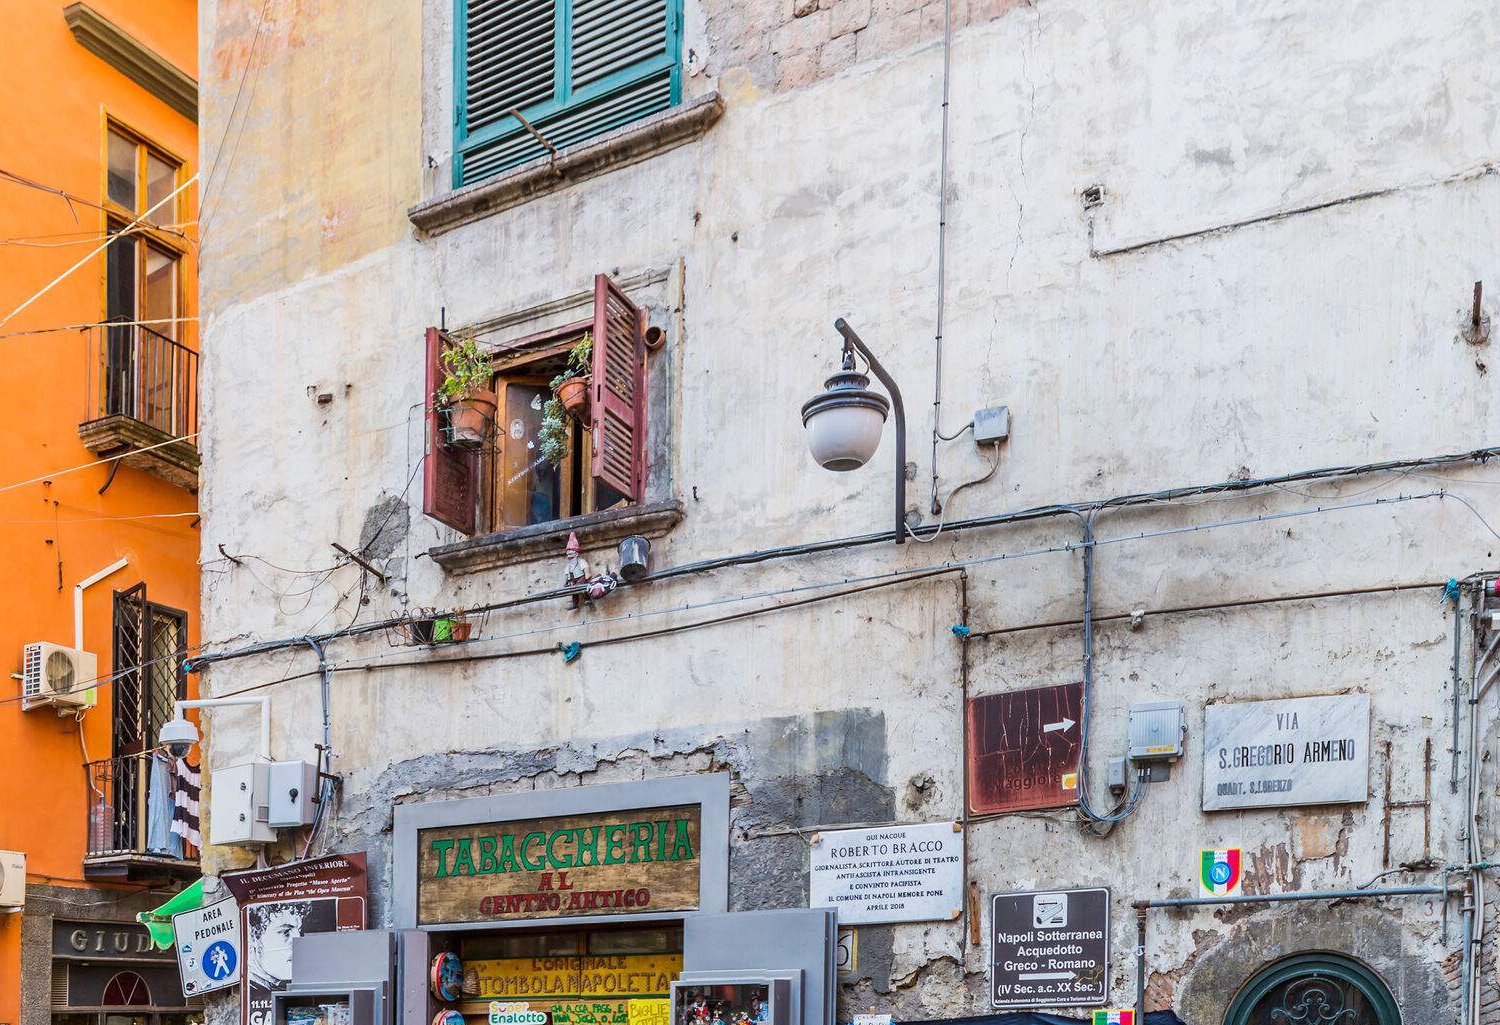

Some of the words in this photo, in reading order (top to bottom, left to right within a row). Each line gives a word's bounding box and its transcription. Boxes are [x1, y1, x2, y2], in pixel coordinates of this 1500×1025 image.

[1276, 712, 1299, 730] VIA
[1219, 743, 1294, 769] S.GREGORIO
[1303, 738, 1355, 763] ARMENO
[879, 832, 906, 840] NACQUE
[431, 818, 694, 879] TABACCHERIA
[831, 844, 888, 858] ROBERTO
[893, 840, 943, 854] BRACCO
[895, 858, 922, 866] AUTORE
[933, 856, 959, 864] TEATRO
[251, 867, 301, 883] DECUMANO
[303, 860, 349, 871] INFERIORE
[836, 871, 881, 880] ANTIFASCISTA
[883, 868, 936, 877] INTRANSIGENTE
[538, 872, 574, 891] AL
[855, 881, 889, 890] CONVINTO
[317, 887, 330, 895] Open
[836, 894, 863, 902] COMUNE
[898, 890, 924, 898] MEMORE
[926, 889, 943, 897] PONE
[479, 892, 560, 915] CENTRO
[567, 887, 650, 910] ANTICO
[1424, 900, 1434, 917] 3
[202, 907, 222, 923] AREA
[194, 919, 235, 940] PEDONALE
[998, 931, 1034, 945] Napoli
[1036, 930, 1103, 942] Sotterranea
[1017, 945, 1083, 958] Acquedotto
[532, 956, 627, 971] L'ORIGINALE
[1004, 960, 1038, 971] Greco
[1048, 959, 1096, 970] Romano
[479, 974, 565, 995] TOMBOLA
[997, 984, 1012, 996] (IV
[1014, 984, 1036, 994] Sec.
[1037, 985, 1055, 993] a.c.
[1057, 982, 1071, 992] XX
[1074, 982, 1096, 992] Sec.
[491, 1013, 545, 1024] Enalotto
